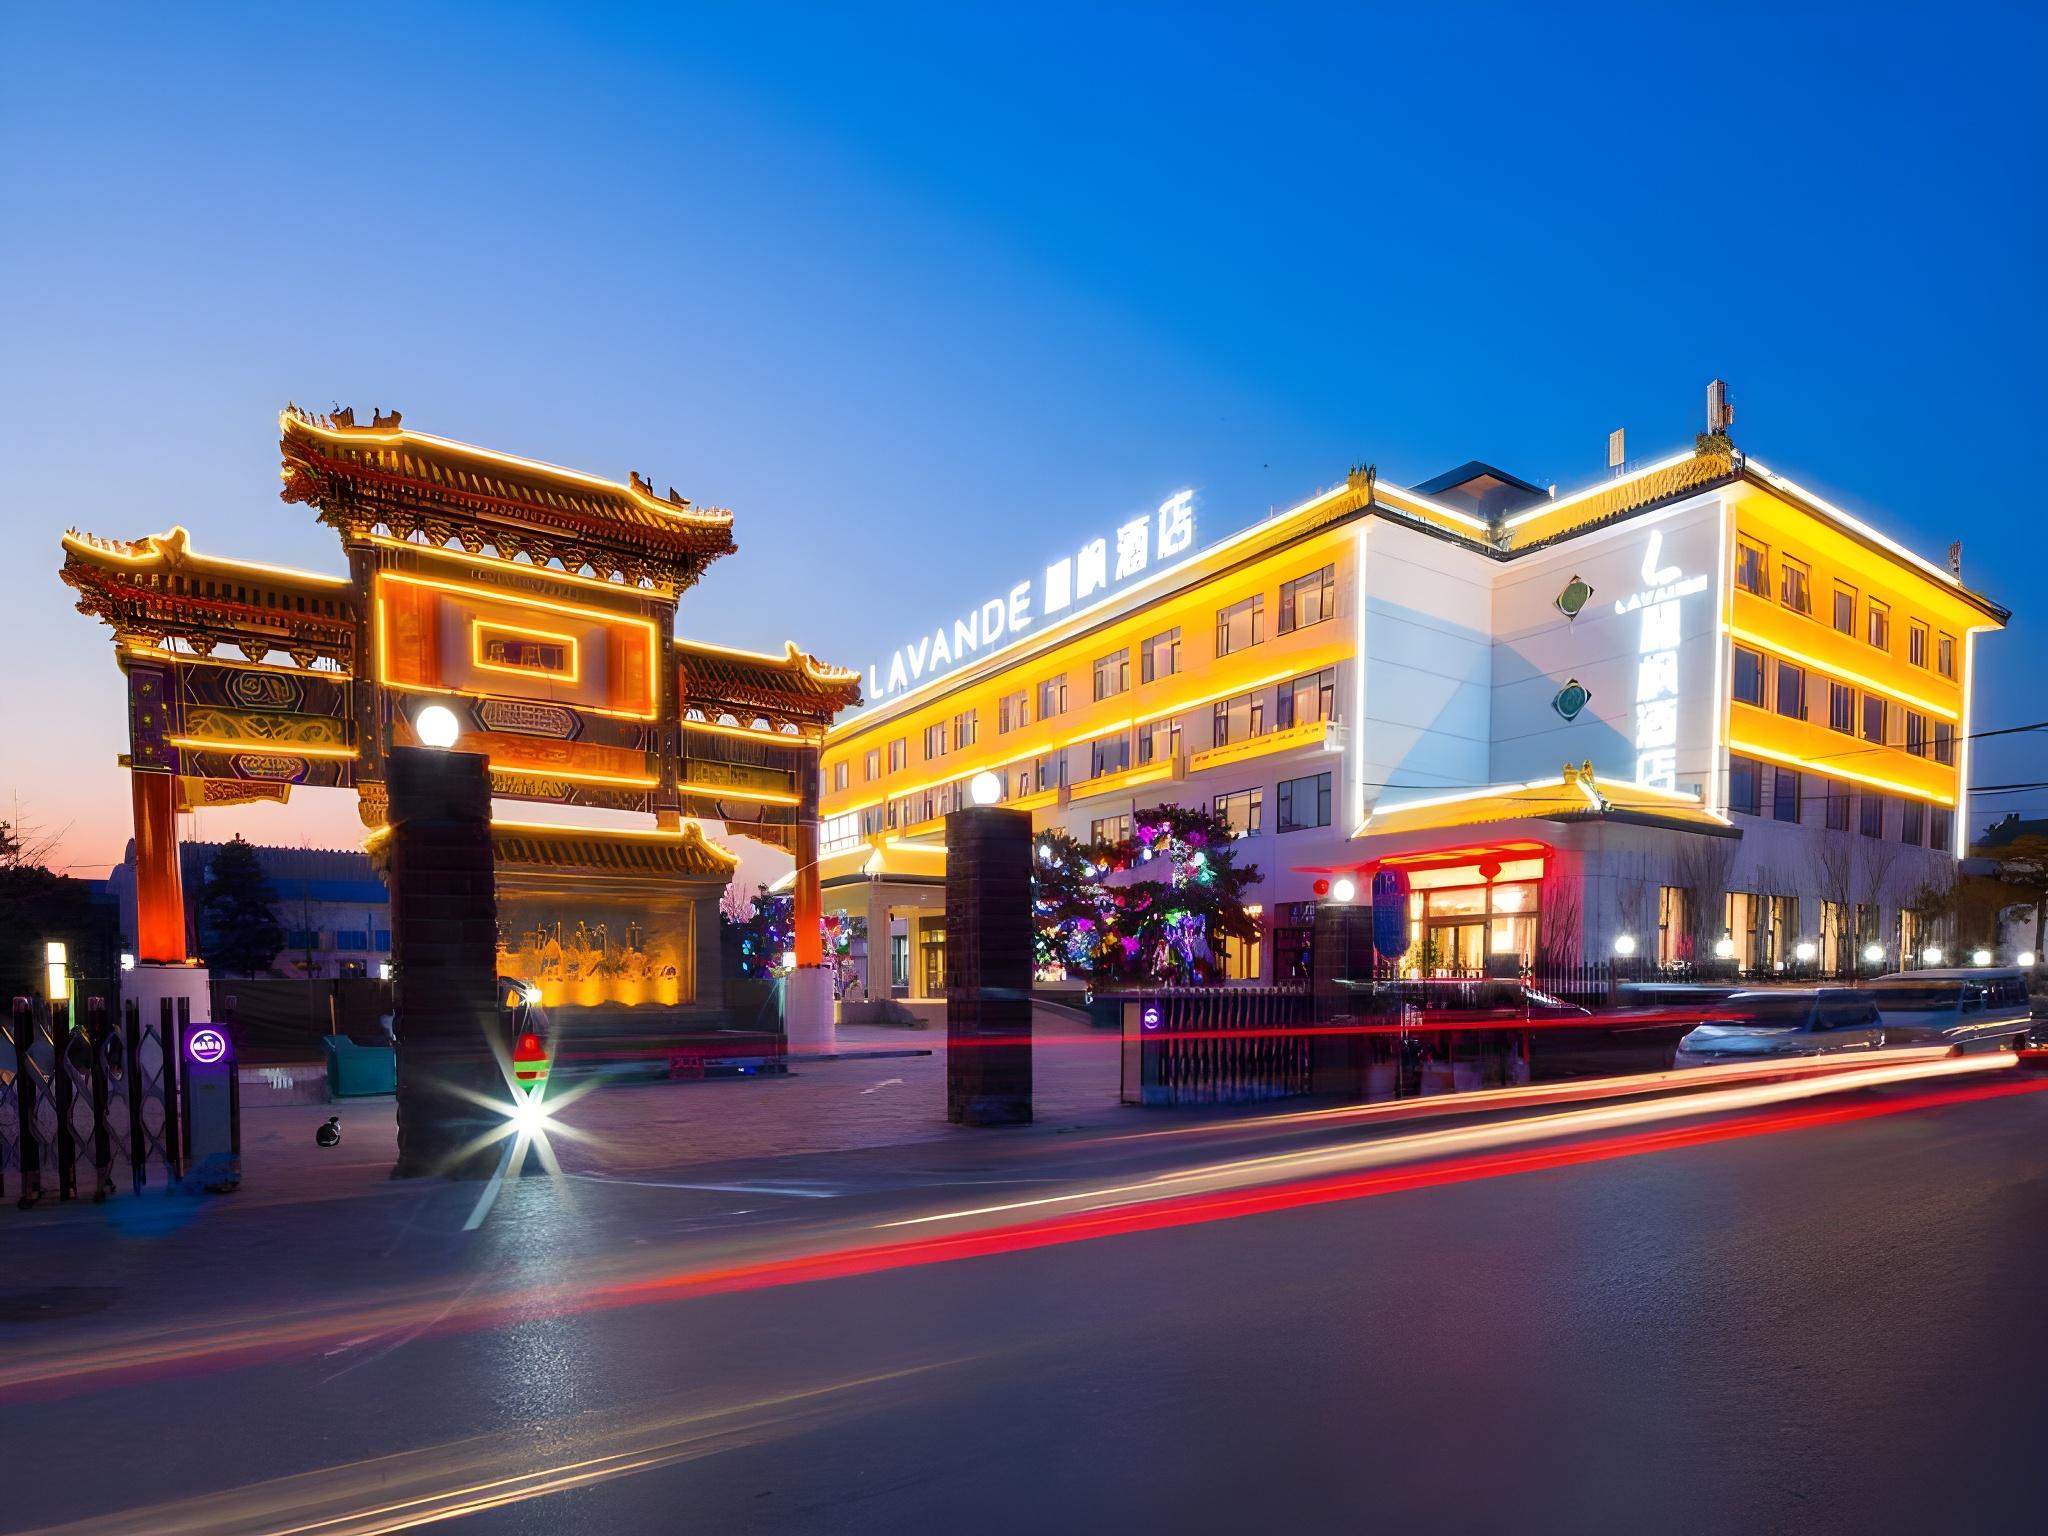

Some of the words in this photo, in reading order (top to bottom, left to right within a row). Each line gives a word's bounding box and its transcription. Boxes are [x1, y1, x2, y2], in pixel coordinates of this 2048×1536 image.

[869, 580, 1032, 700] LAVANDE
[1045, 490, 1192, 614] 酒店
[1615, 574, 1708, 614] LAVA
